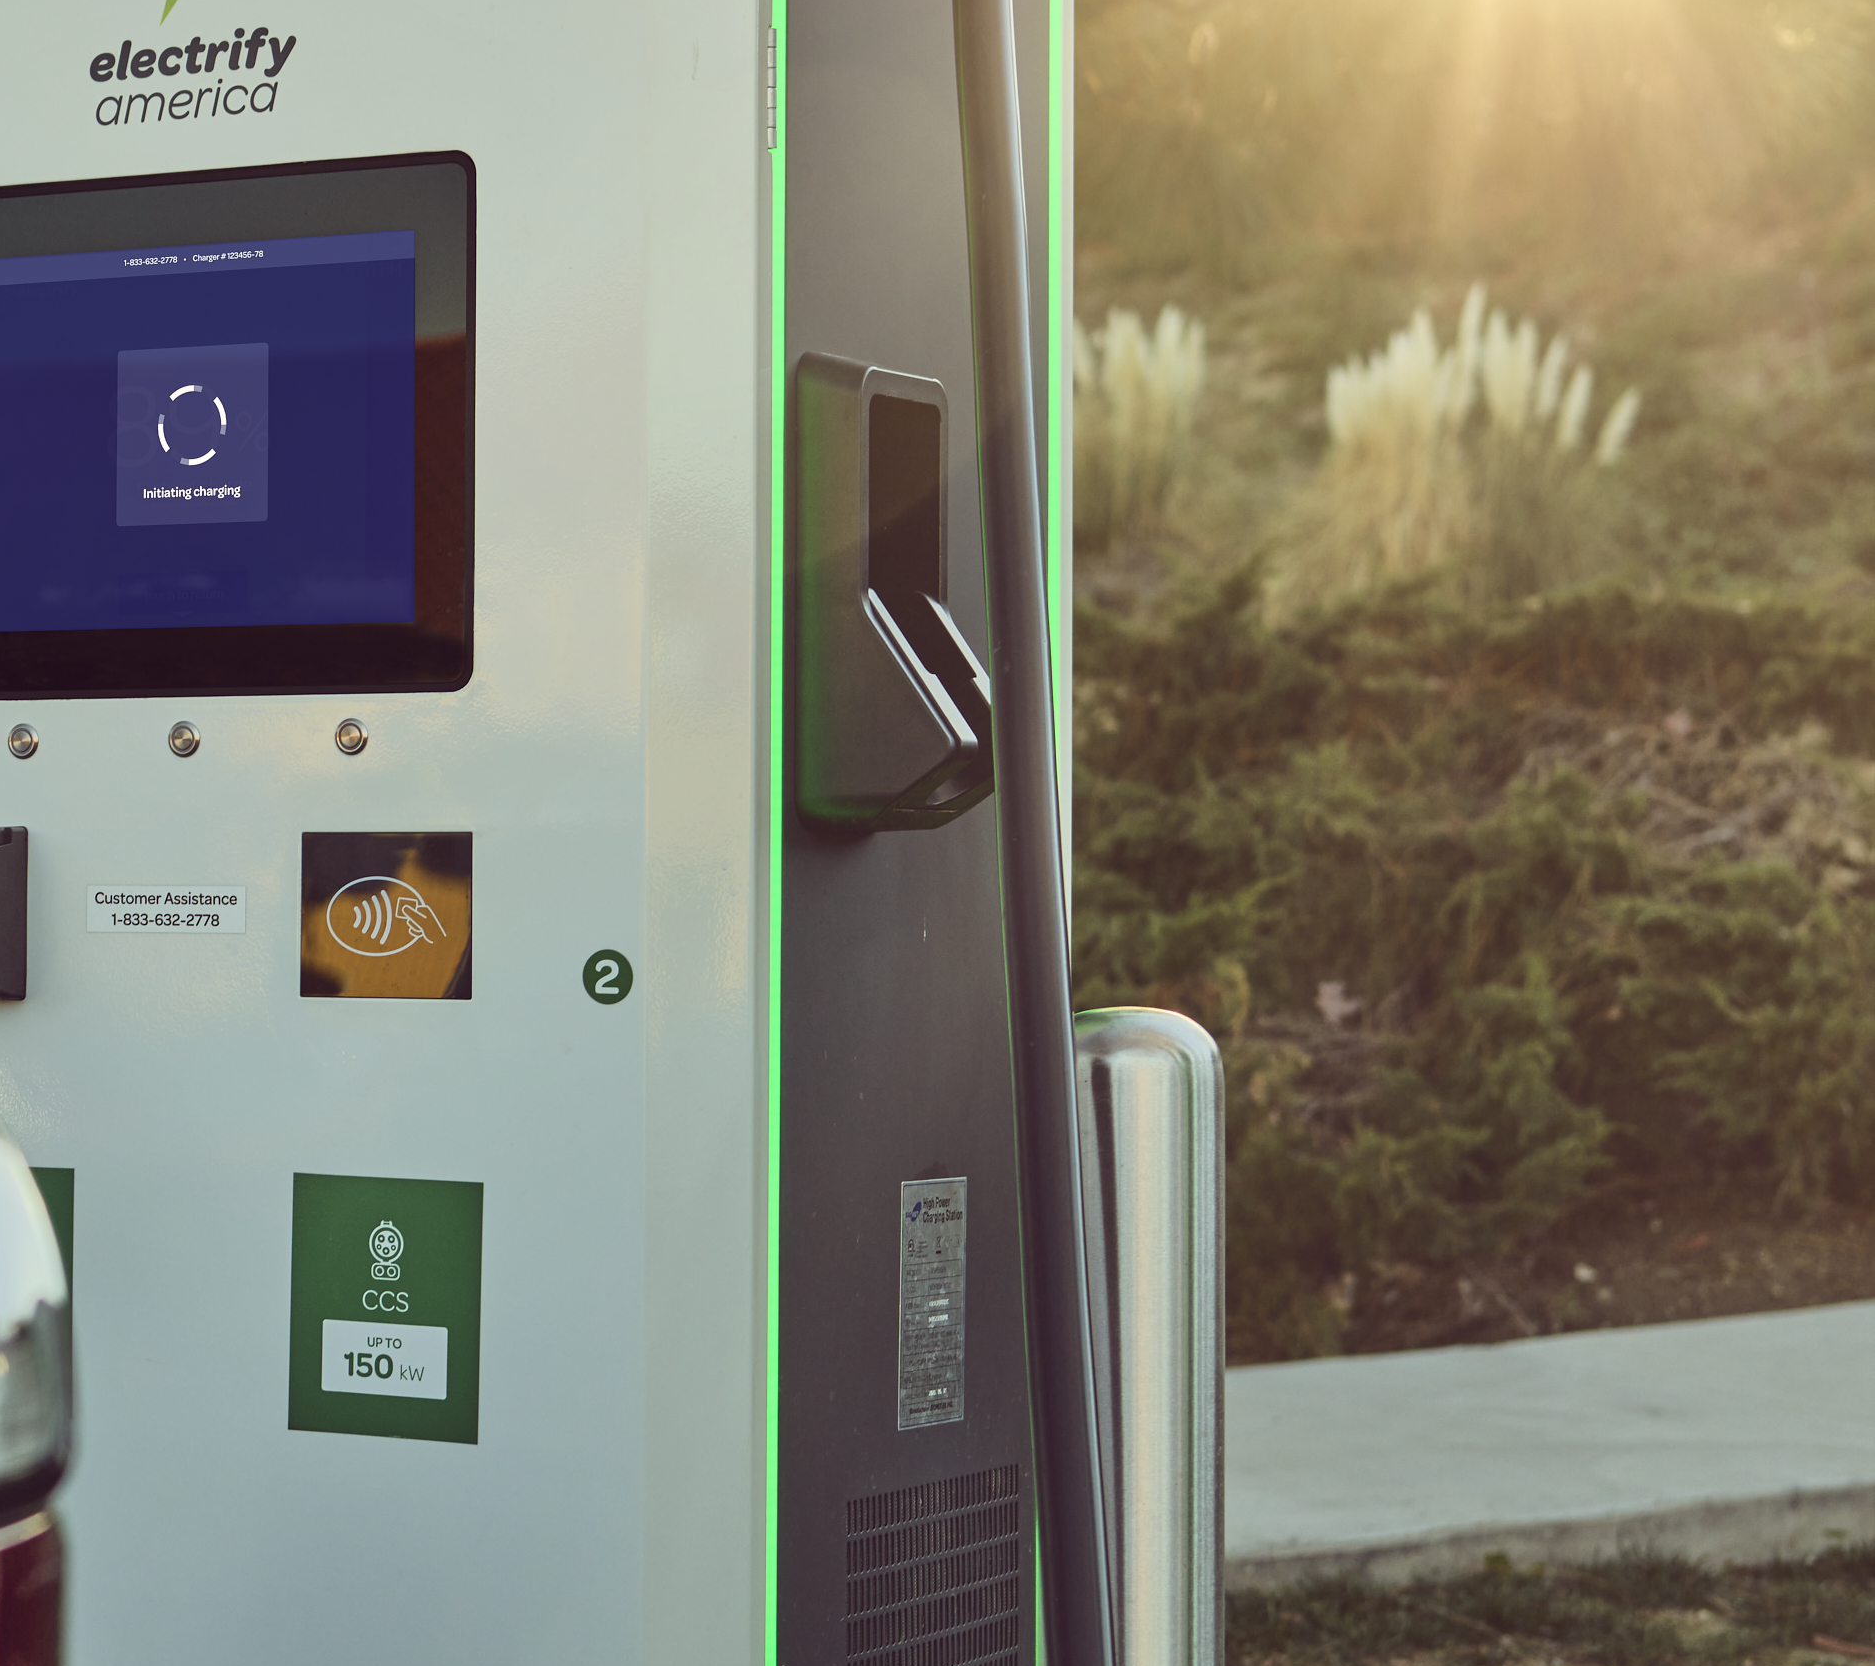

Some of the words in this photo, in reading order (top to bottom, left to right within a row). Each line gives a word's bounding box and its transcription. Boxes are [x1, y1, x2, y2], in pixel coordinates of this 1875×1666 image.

[89, 27, 297, 83] electrify
[95, 78, 279, 126] america
[123, 256, 178, 267] 1-833-632-2778
[192, 254, 220, 263] Charger
[143, 486, 192, 500] Initiating
[193, 484, 241, 499] charging
[94, 891, 161, 905] Customer
[164, 891, 238, 906] Assistance
[111, 912, 220, 927] 1-833-632-2778
[594, 958, 620, 995] 2
[922, 1197, 935, 1211] High
[935, 1196, 951, 1209] Power
[922, 1210, 945, 1224] Charging
[945, 1208, 963, 1222] Station
[362, 1289, 409, 1313] CCS
[367, 1336, 383, 1348] UP
[384, 1337, 402, 1349] TO
[343, 1351, 394, 1380] 150
[400, 1364, 425, 1382] kW
